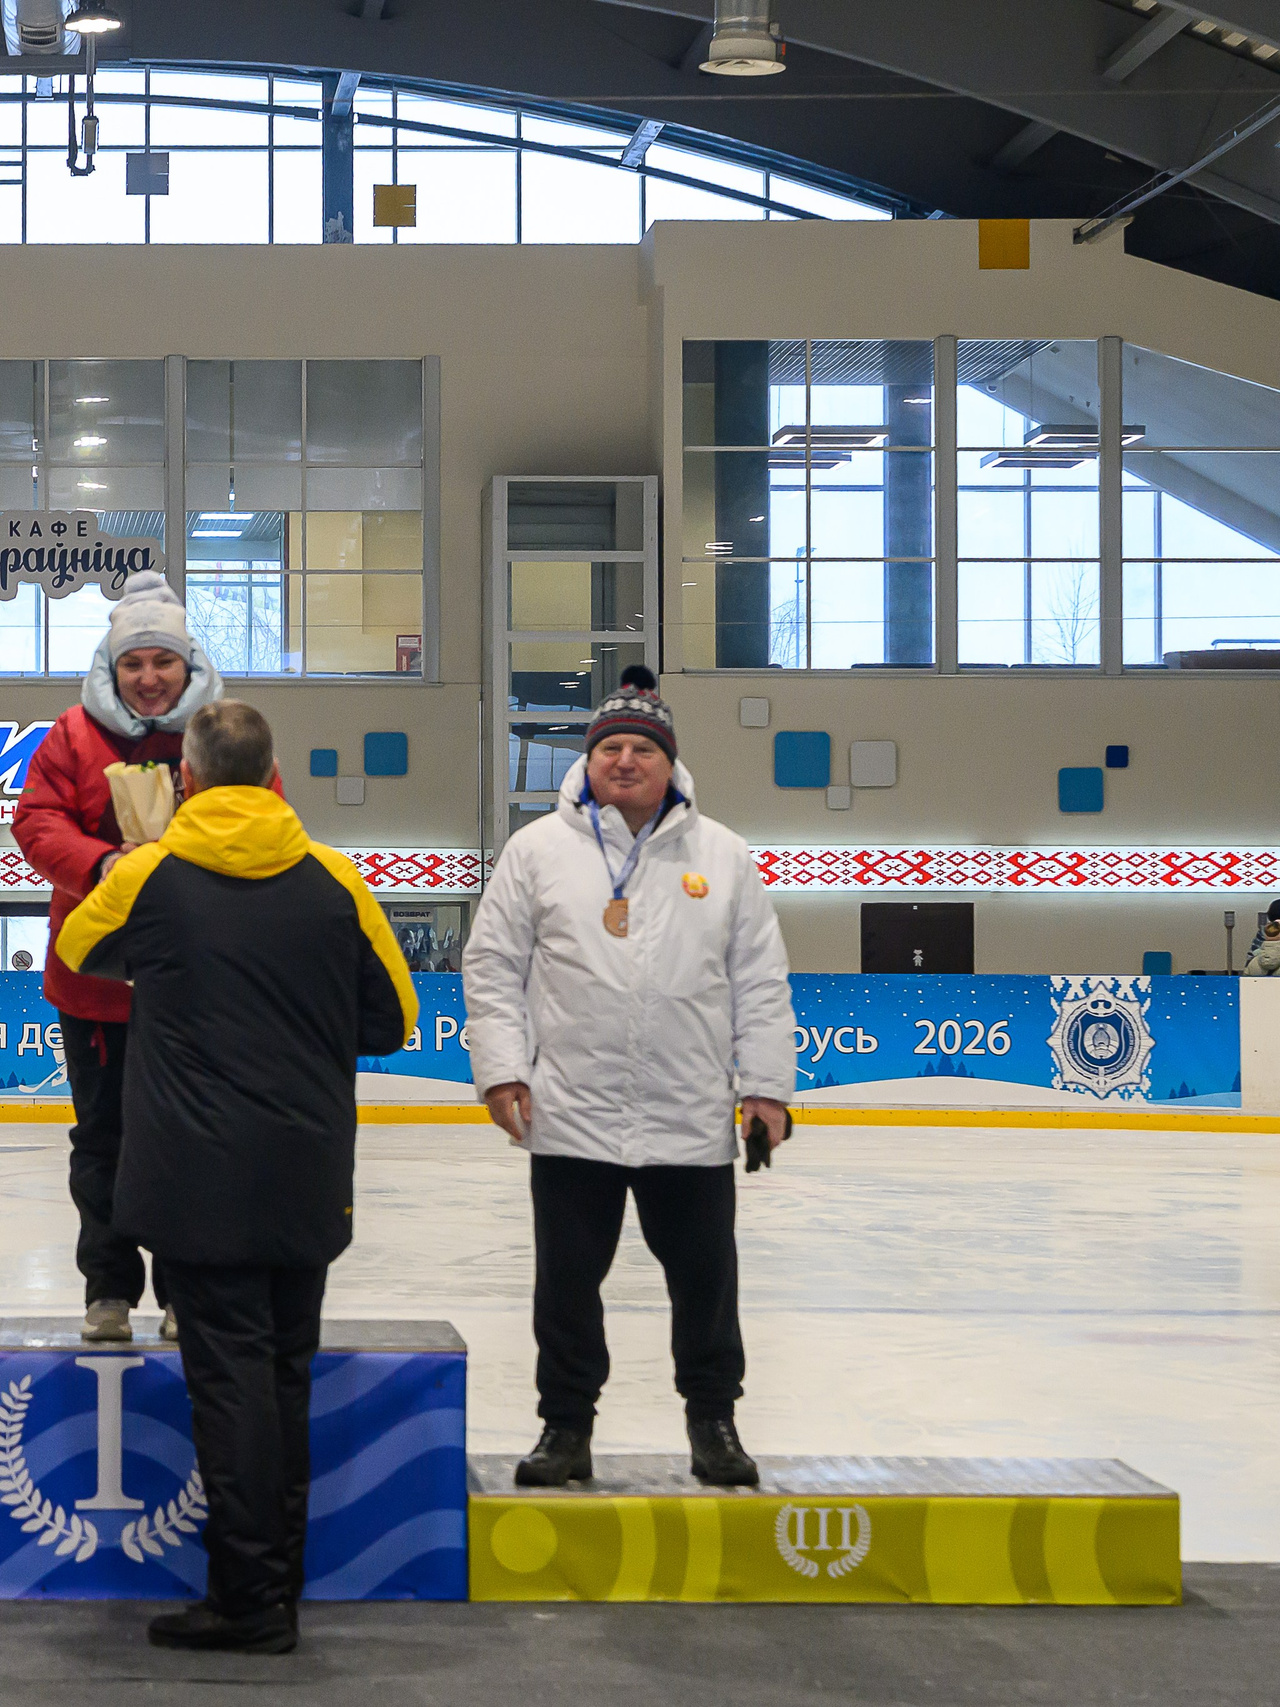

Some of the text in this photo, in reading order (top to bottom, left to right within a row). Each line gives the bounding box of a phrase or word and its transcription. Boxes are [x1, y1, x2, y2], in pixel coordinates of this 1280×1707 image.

[9, 520, 88, 538] КАФЕ
[17, 1021, 65, 1057] де
[434, 1014, 472, 1052] Ре
[912, 1018, 1012, 1056] 2026
[74, 1356, 146, 1511] I
[793, 1507, 856, 1550] III
